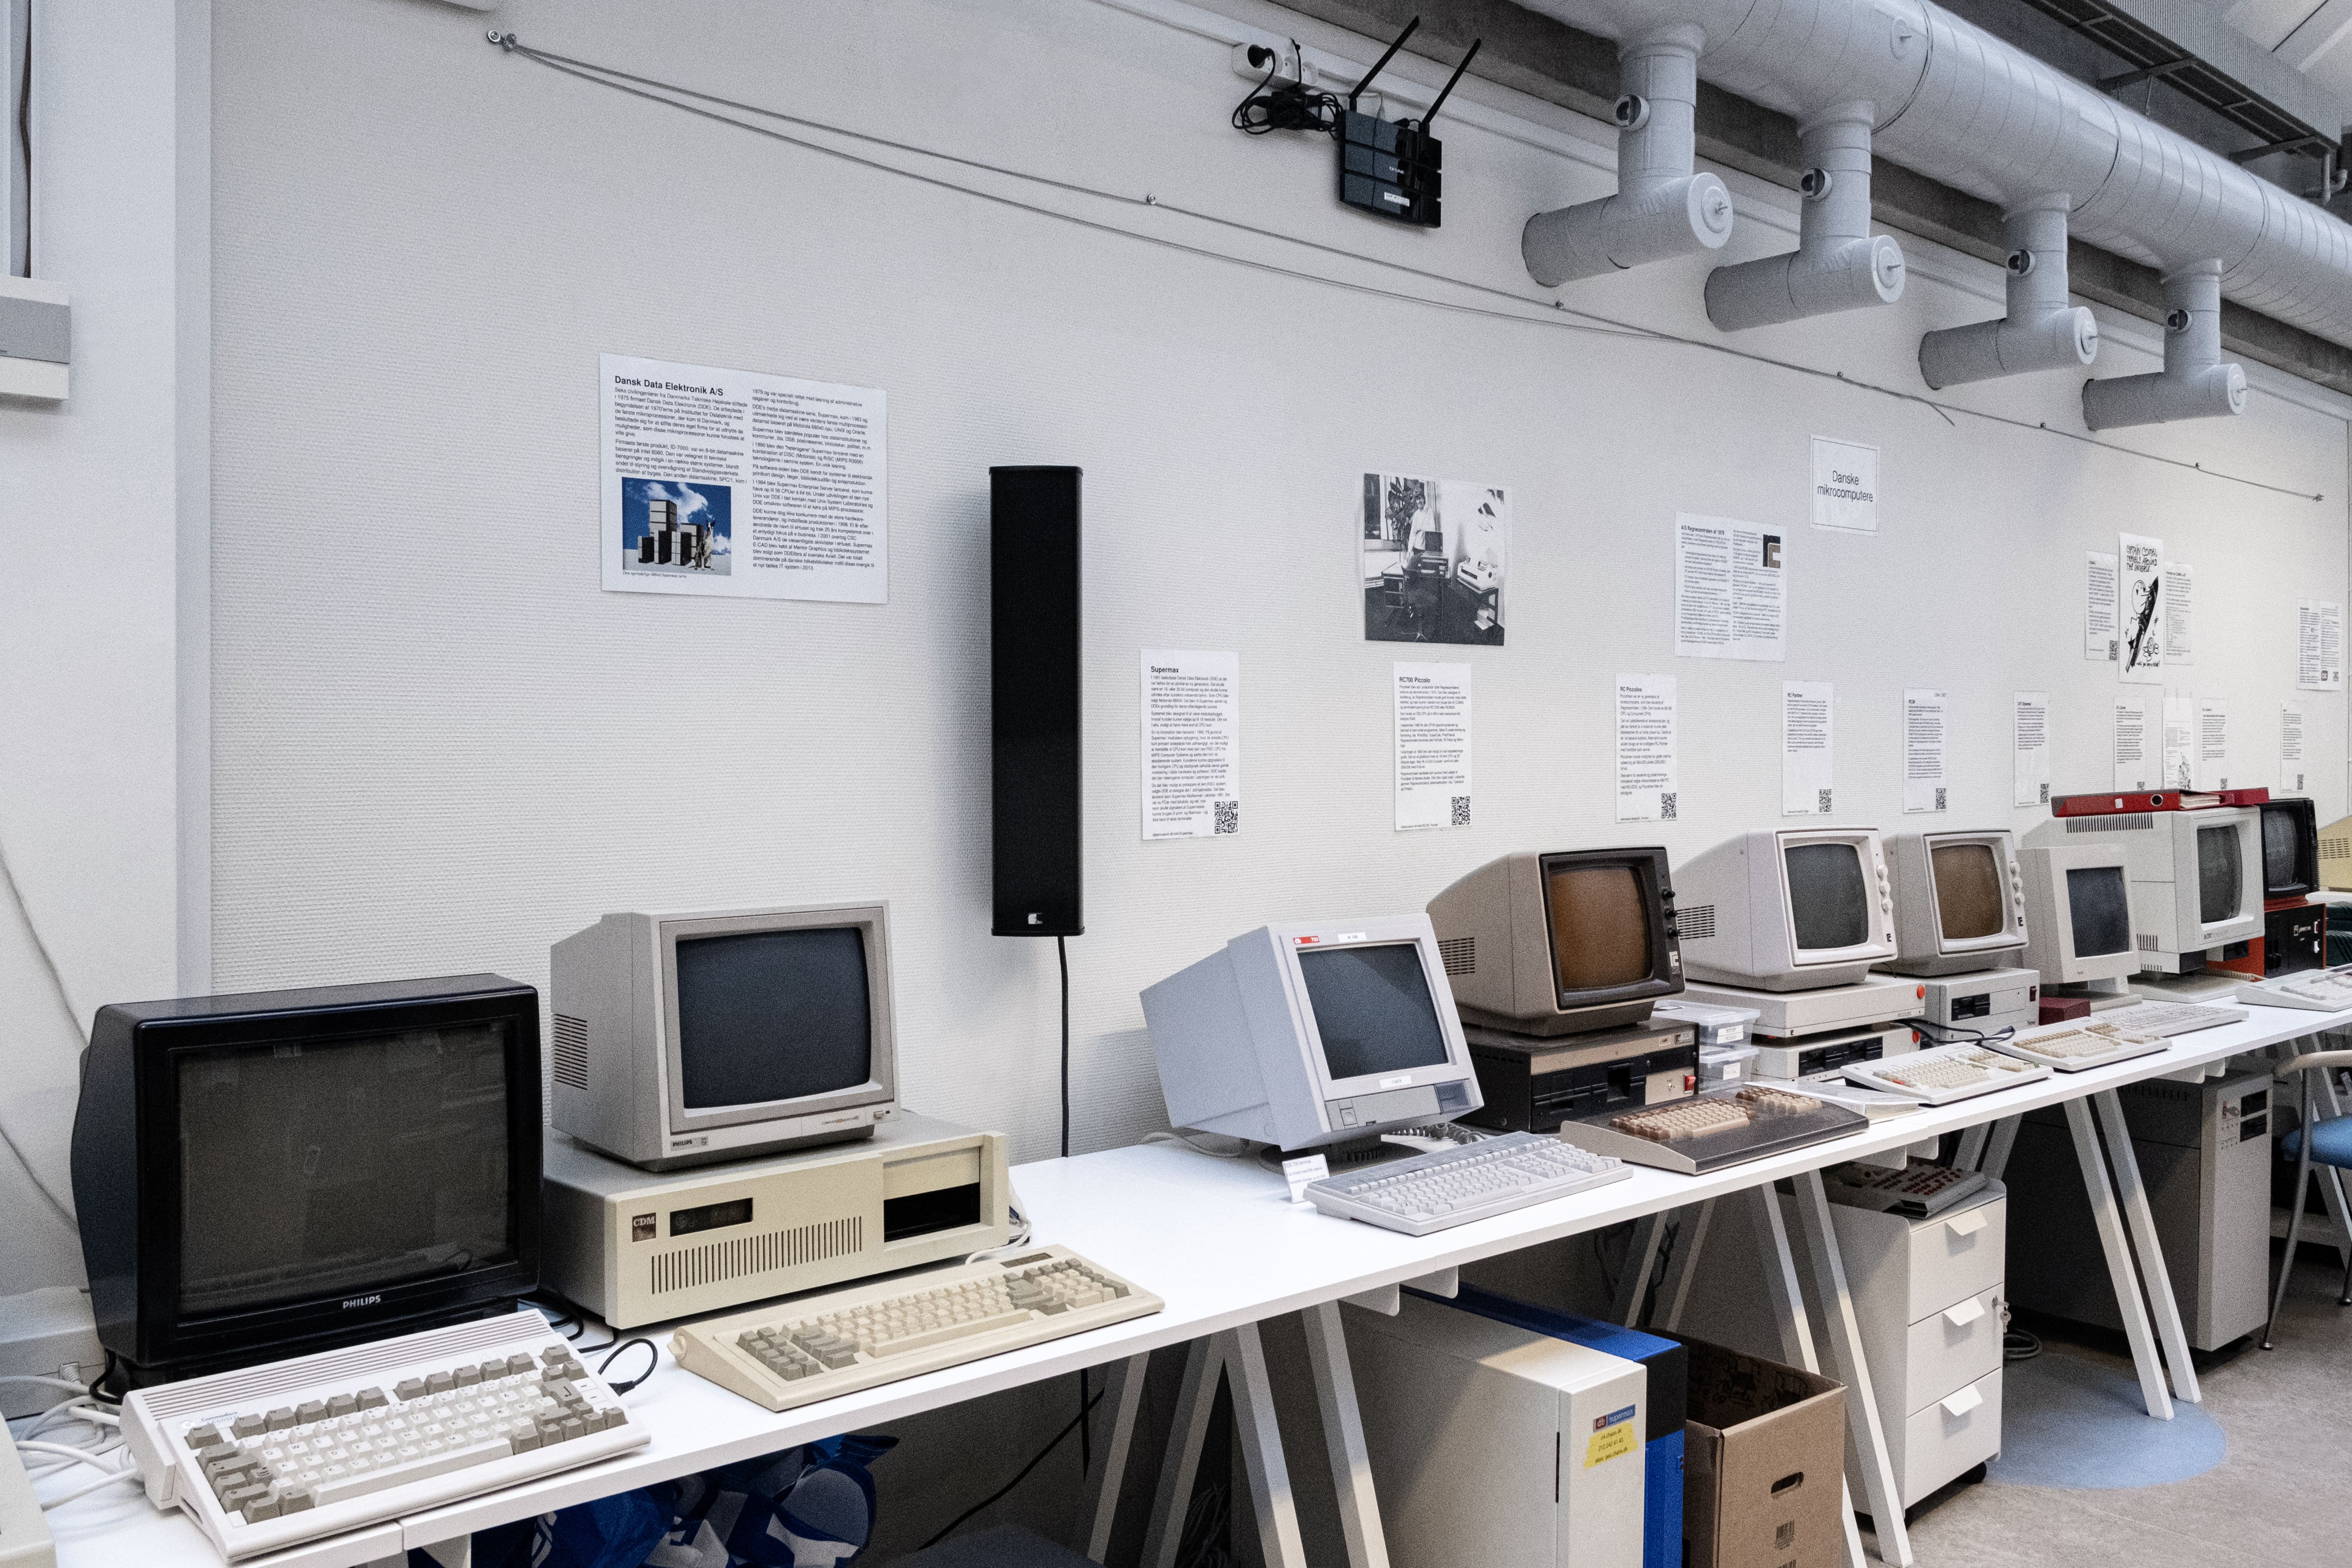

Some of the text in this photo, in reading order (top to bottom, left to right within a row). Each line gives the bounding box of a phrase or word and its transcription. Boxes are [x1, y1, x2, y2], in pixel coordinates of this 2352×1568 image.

[615, 376, 723, 396] Dansk Data Elektronik A/S
[1833, 470, 1859, 485] Danske
[1817, 484, 1873, 503] mikrocomputere
[633, 1216, 655, 1227] CDM
[343, 1294, 381, 1310] PHILIPS
[201, 1412, 238, 1421] Commodore
